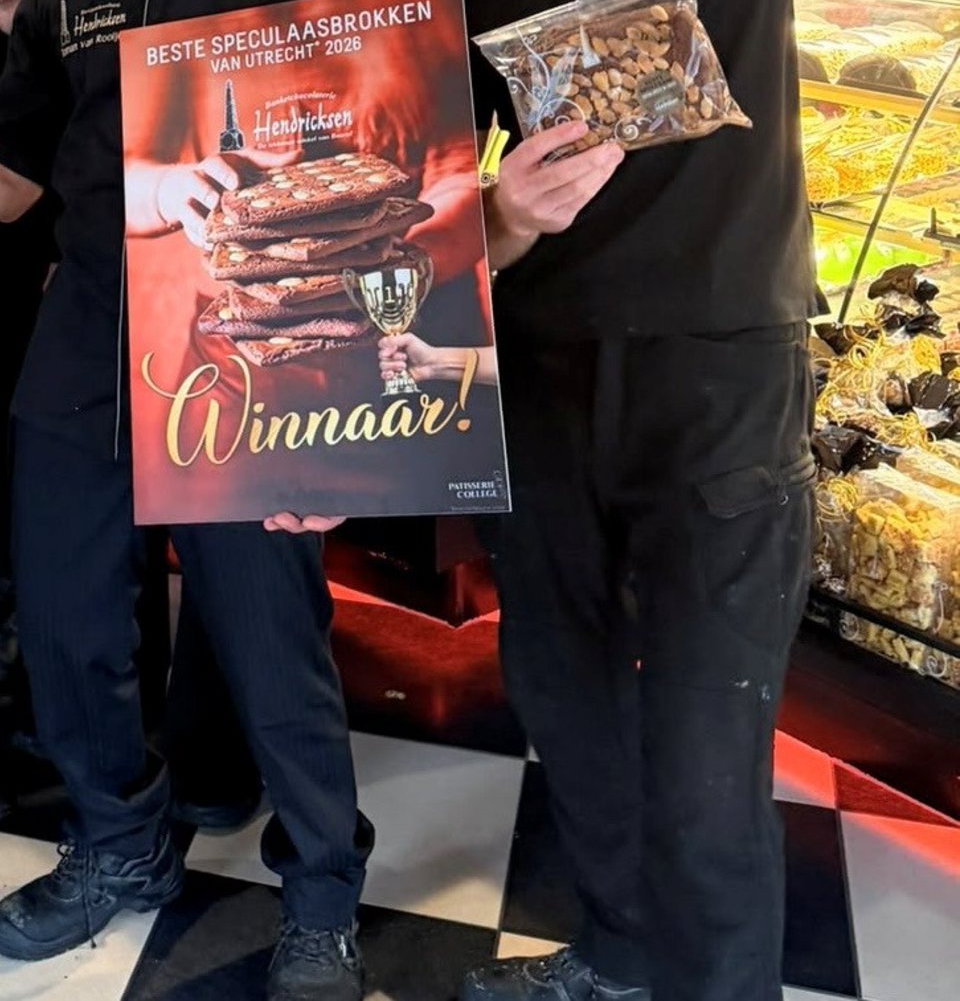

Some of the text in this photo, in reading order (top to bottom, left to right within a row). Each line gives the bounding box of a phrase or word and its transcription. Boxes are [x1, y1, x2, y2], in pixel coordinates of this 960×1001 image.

[146, 0, 433, 66] BESTE SPECULAASBROKKEN
[210, 57, 241, 74] VAN
[325, 35, 362, 56] 2026
[253, 102, 353, 142] Hendricksen
[141, 348, 480, 467] Winnaar!
[448, 481, 495, 492] PATISSERIE
[456, 489, 497, 499] COLLEGE
